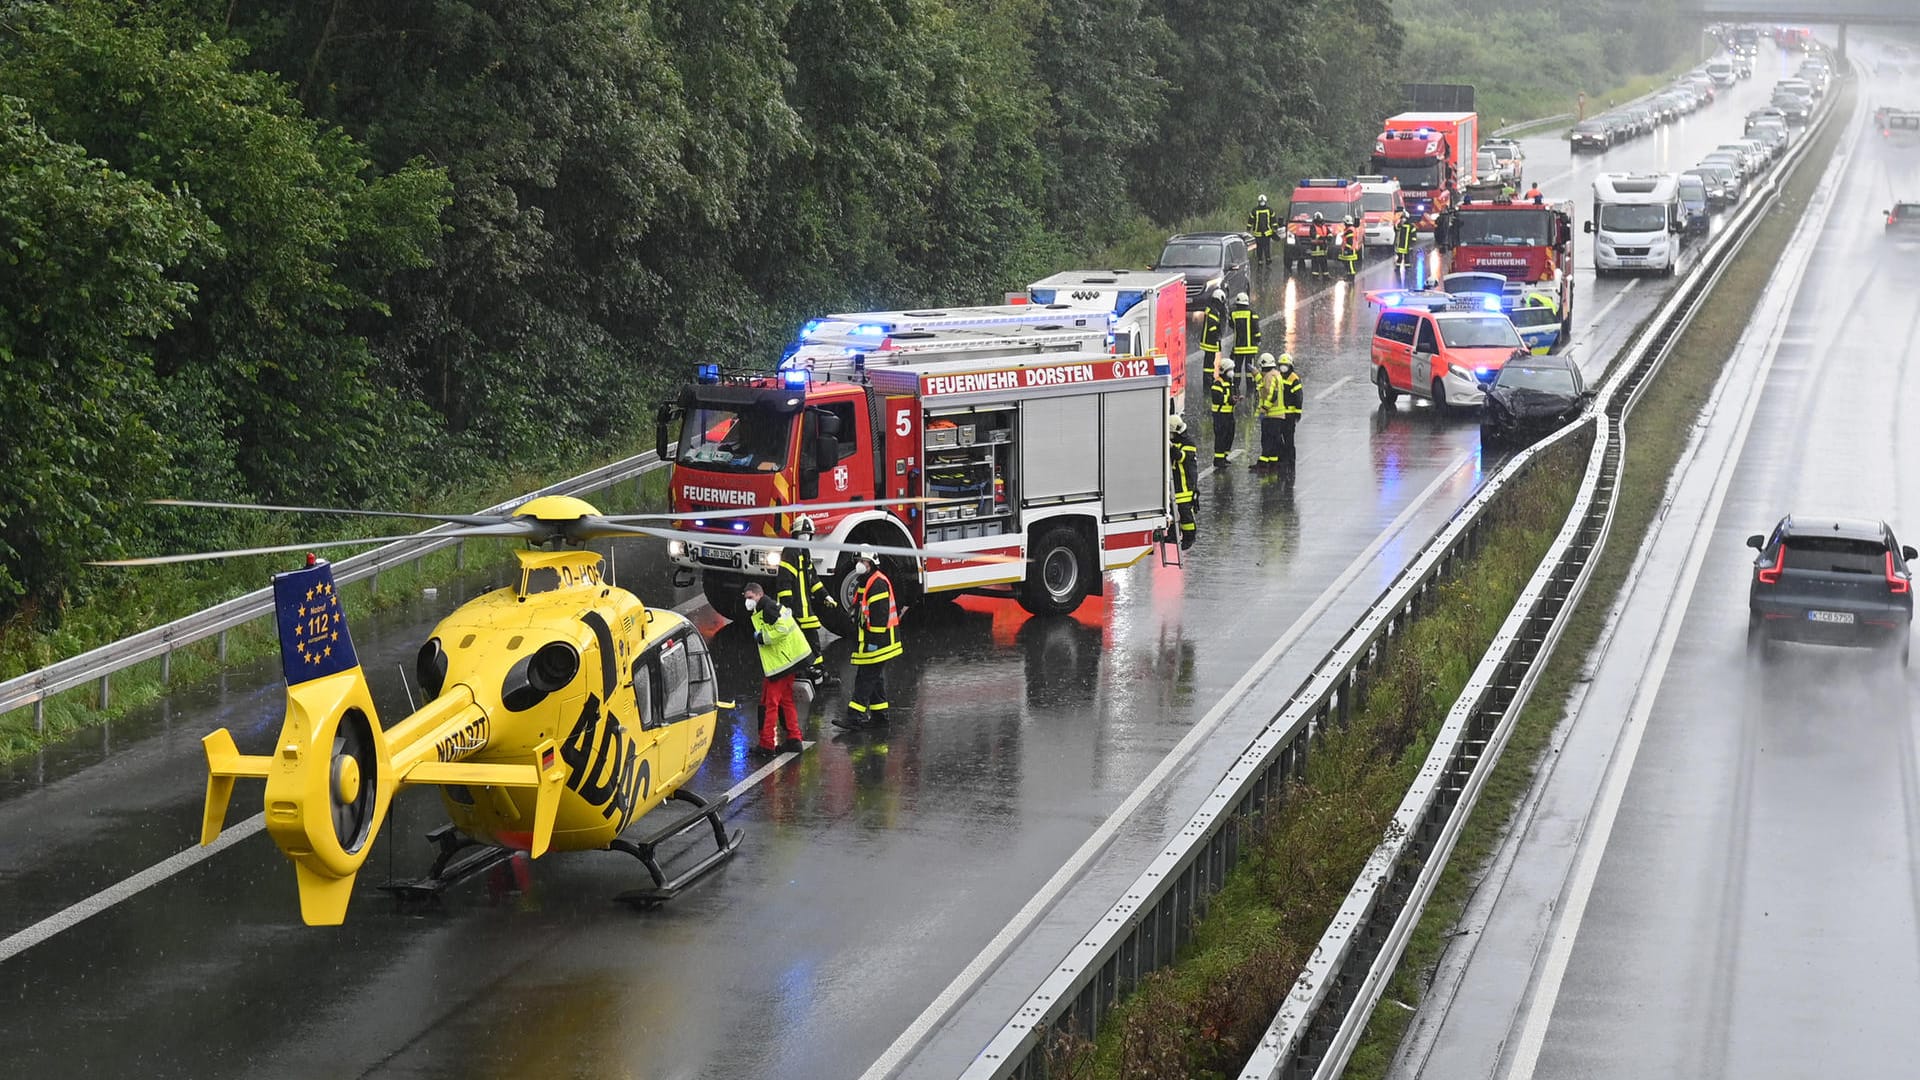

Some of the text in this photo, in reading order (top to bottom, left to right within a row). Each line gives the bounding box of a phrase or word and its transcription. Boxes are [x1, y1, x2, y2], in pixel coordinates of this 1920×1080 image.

[1476, 258, 1527, 266] FEUERWEHR
[926, 359, 1149, 395] FEUERWEHR DORSTEN 112
[895, 409, 912, 437] 5
[683, 485, 757, 506] FEUERWEHR
[308, 613, 329, 636] 112
[436, 716, 486, 763] NOTARZT
[560, 691, 651, 834] ADAC
